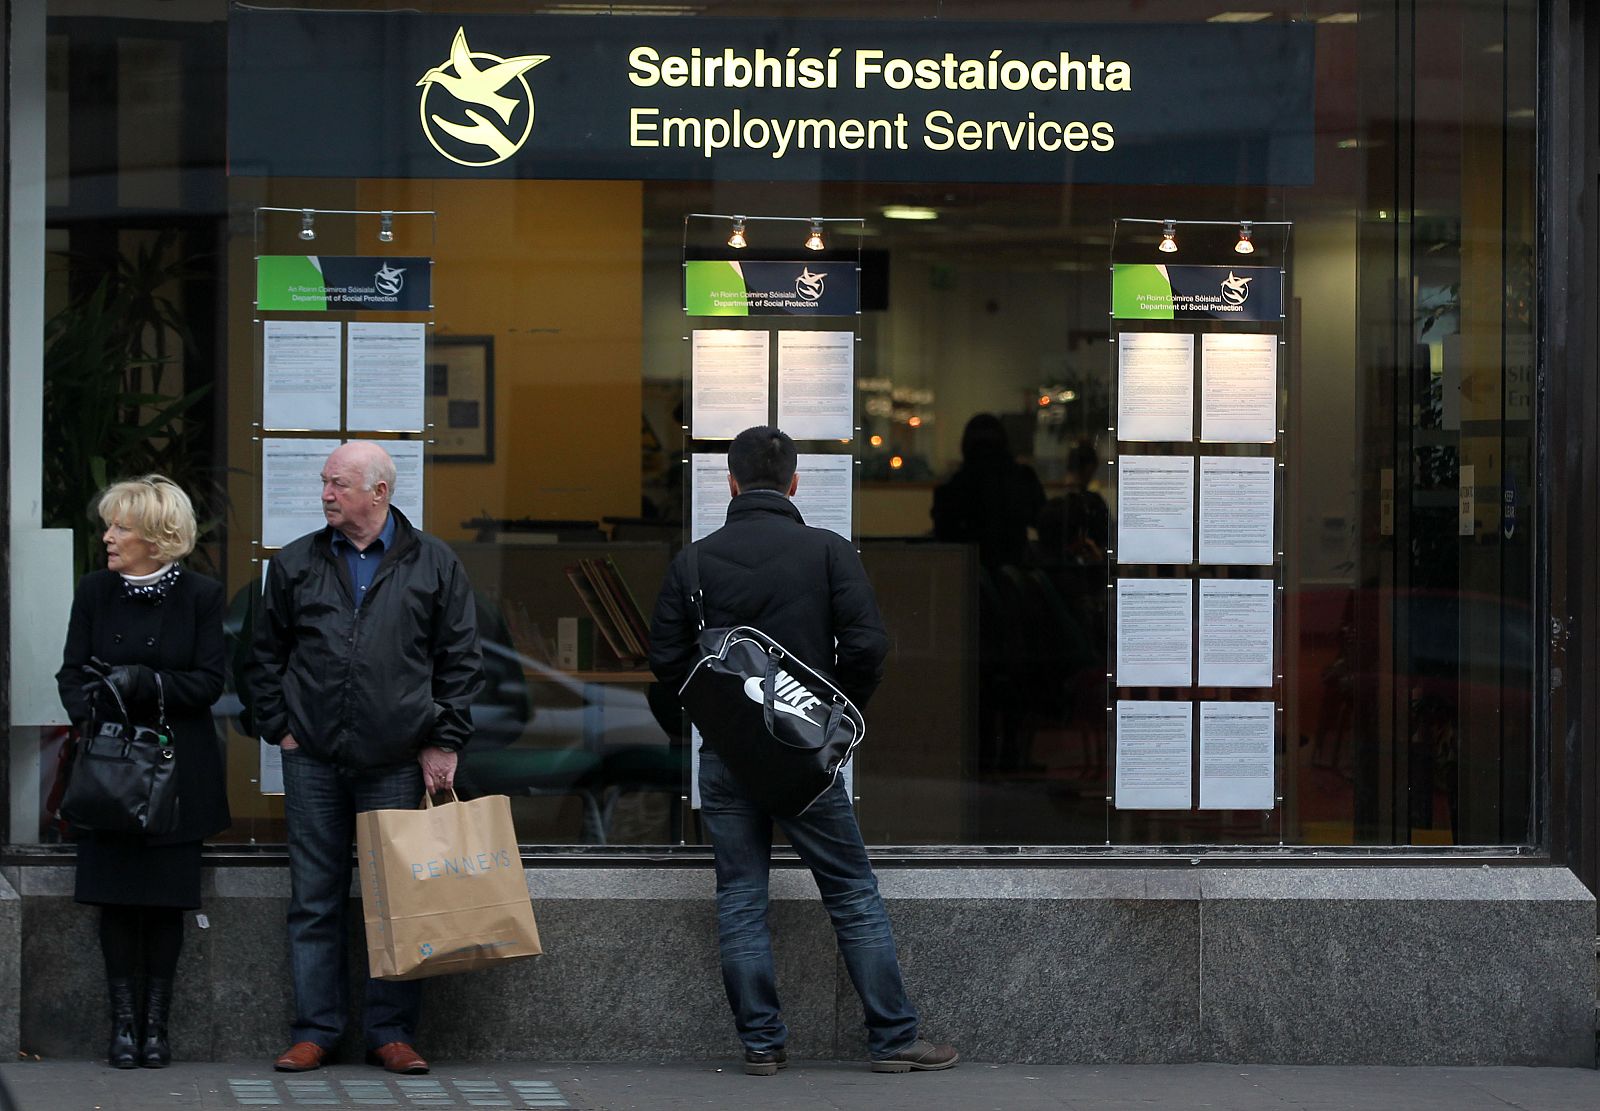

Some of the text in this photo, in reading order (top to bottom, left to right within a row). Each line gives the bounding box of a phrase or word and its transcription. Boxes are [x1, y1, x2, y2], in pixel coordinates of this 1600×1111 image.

[627, 46, 1132, 91] Seirbhísí Fostaíochta
[629, 108, 1115, 158] Employment Services
[1136, 294, 1145, 302] An
[1140, 303, 1243, 311] Department of Social Protection
[773, 670, 822, 716] NIKE
[411, 848, 511, 880] PENNEYS
